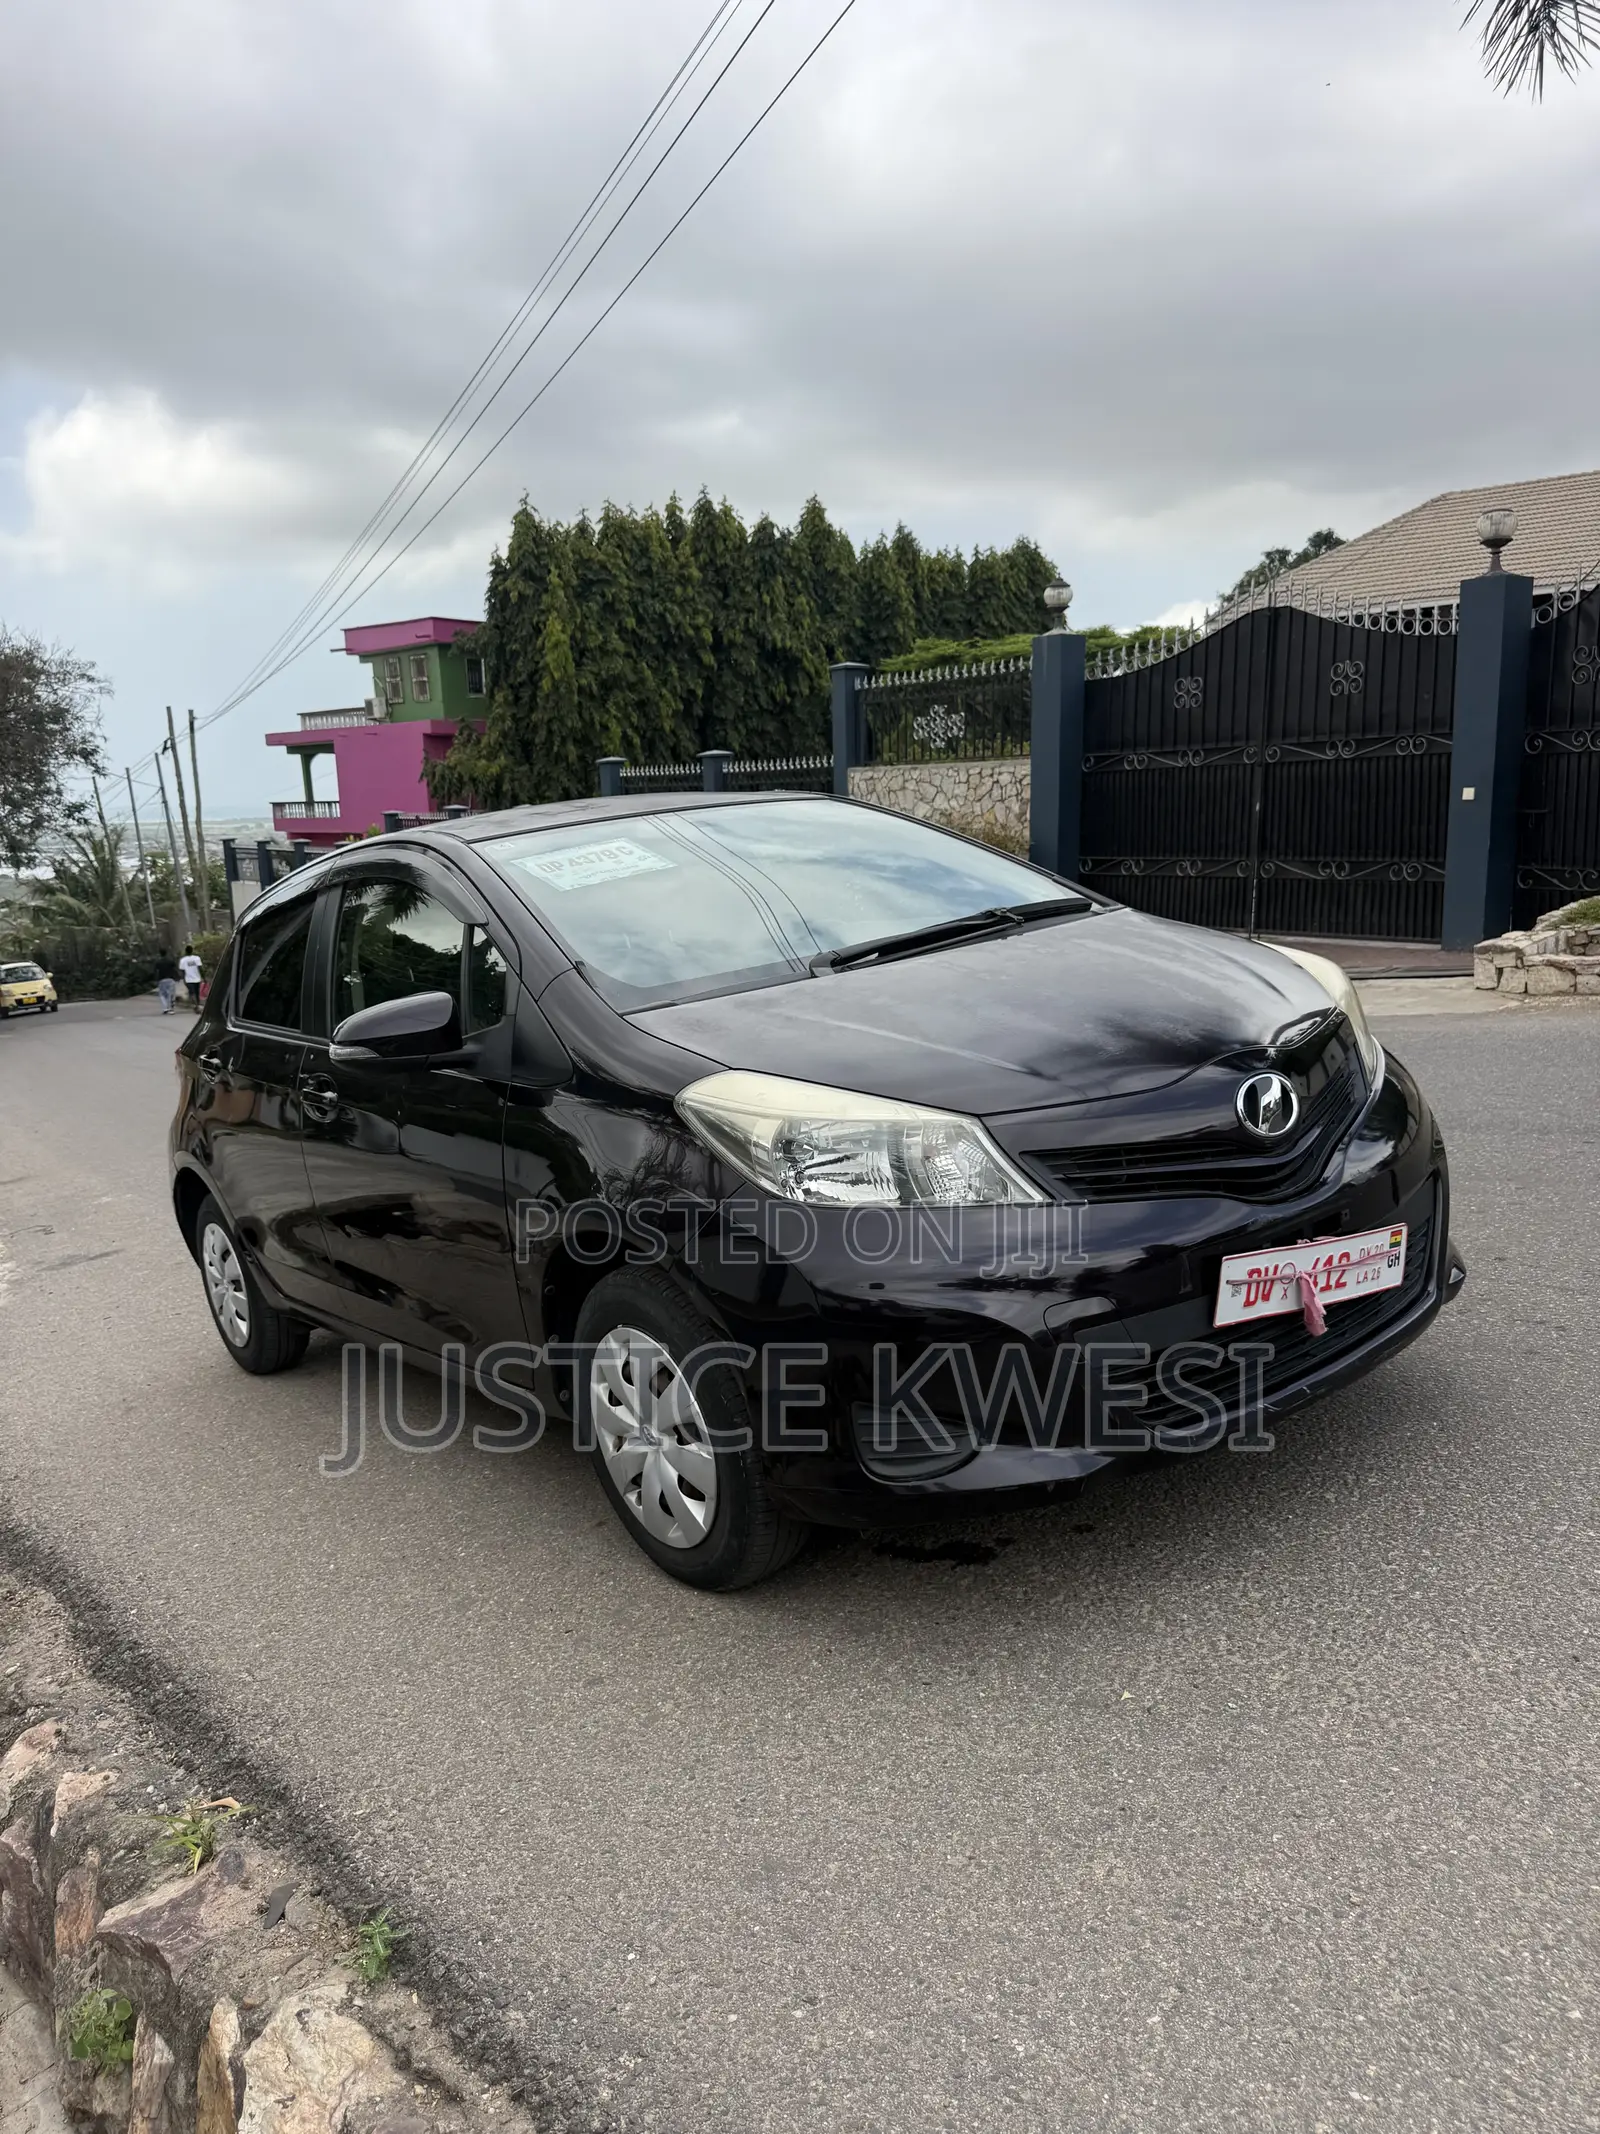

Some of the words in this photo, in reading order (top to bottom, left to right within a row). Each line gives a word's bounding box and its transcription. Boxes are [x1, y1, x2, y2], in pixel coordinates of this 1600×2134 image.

[567, 848, 620, 868] 4379
[615, 846, 635, 857] C
[1387, 1249, 1401, 1269] GH
[1243, 1263, 1279, 1307] DV
[1356, 1270, 1369, 1285] LA
